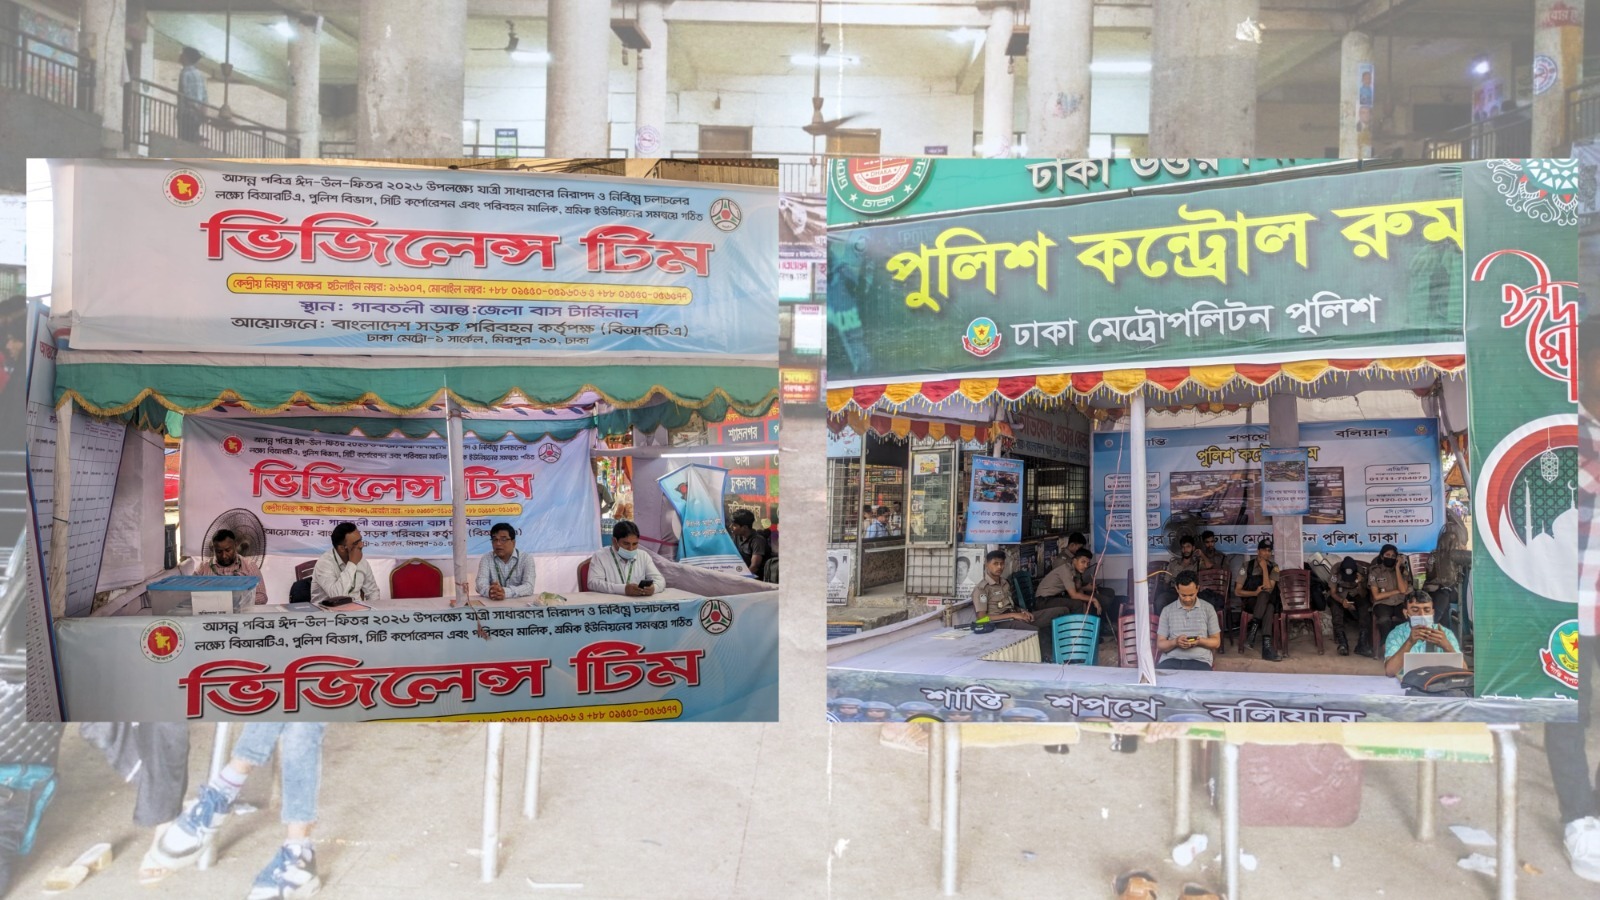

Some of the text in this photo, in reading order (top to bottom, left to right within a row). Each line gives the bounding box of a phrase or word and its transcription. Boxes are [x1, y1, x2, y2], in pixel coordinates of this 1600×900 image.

[222, 173, 256, 187] আসন্ন
[261, 172, 292, 186] পবিত্র
[295, 174, 383, 190] ঈদ-উল-ফিতর
[387, 181, 423, 191] ২০২৬
[477, 183, 501, 196] যাত্রী
[504, 186, 554, 198] সাধারণের
[557, 187, 595, 200] নিরাপদ
[598, 193, 606, 201] ও
[643, 195, 690, 206] চলাচলের
[247, 189, 305, 203] বিআরটিএ,
[308, 191, 338, 204] পুলিশ
[341, 193, 377, 206] বিভাগ,
[380, 194, 401, 206] সিটি
[404, 196, 456, 208] কর্পোরেশন
[459, 200, 480, 211] এবং
[483, 199, 524, 213] পরিবহন
[527, 203, 562, 215] মালিক,
[565, 204, 591, 216] শ্রমিক
[681, 211, 704, 222] গঠিত
[200, 209, 562, 270] ভিজিলেন্স
[580, 224, 715, 277] টিম
[886, 226, 1057, 312] পুলিশ
[1068, 204, 1319, 285] কন্ট্রোল
[1331, 198, 1463, 261] রুম
[233, 276, 262, 290] কেন্দ্রীয়
[296, 281, 322, 290] কক্ষের
[327, 279, 361, 292] হটলাইন
[428, 282, 460, 294] মোবাইল
[488, 286, 508, 295] +৮৮
[352, 300, 425, 315] গাবতলী
[529, 306, 562, 317] বাস
[568, 304, 639, 319] টার্মিনাল
[1010, 317, 1078, 348] ঢাকা
[1088, 300, 1275, 345] মেট্রোপলিটন
[1286, 290, 1381, 336] পুলিশ
[331, 319, 411, 332] বাংলাদেশ
[416, 321, 460, 334] সড়ক
[465, 319, 533, 334] পরিবহন
[538, 321, 595, 336] কর্তৃপক্ষ
[600, 322, 689, 337] (বিআরটিএ)
[367, 334, 393, 342] ঢাকা
[565, 336, 590, 344] ঢাকা
[1334, 427, 1389, 438] বলিয়ান
[1196, 445, 1237, 468] পুলিশ
[249, 459, 446, 501] ভিজিলেন্স
[363, 530, 388, 539] সড়ক
[391, 529, 429, 538] পরিবহন
[1368, 532, 1398, 544] ঢাকা
[203, 620, 239, 635] আসন্ন
[242, 617, 275, 631] পবিত্র
[278, 612, 369, 630] ঈদ-উল-ফিতর
[372, 613, 410, 625] ২০২৬
[492, 608, 544, 621] সাধারণের
[547, 605, 585, 619] নিরাপদ
[588, 607, 595, 616] ও
[633, 602, 680, 615] চলাচলের
[229, 634, 289, 650] বিআরটিএ,
[292, 633, 323, 650] পুলিশ
[325, 631, 364, 646] বিভাগ,
[366, 629, 388, 644] সিটি
[390, 627, 443, 643] কর্পোরেশন
[446, 627, 469, 640] এবং
[517, 624, 552, 637] মালিক,
[554, 622, 582, 636] শ্রমিক
[585, 620, 633, 634] ইউনিয়নের
[670, 616, 693, 628] গঠিত
[178, 640, 706, 718] ভিজিলেন্স টিম
[587, 710, 605, 720] +৮৮
[922, 685, 1010, 712] শান্তি
[1044, 692, 1166, 721] শপথে
